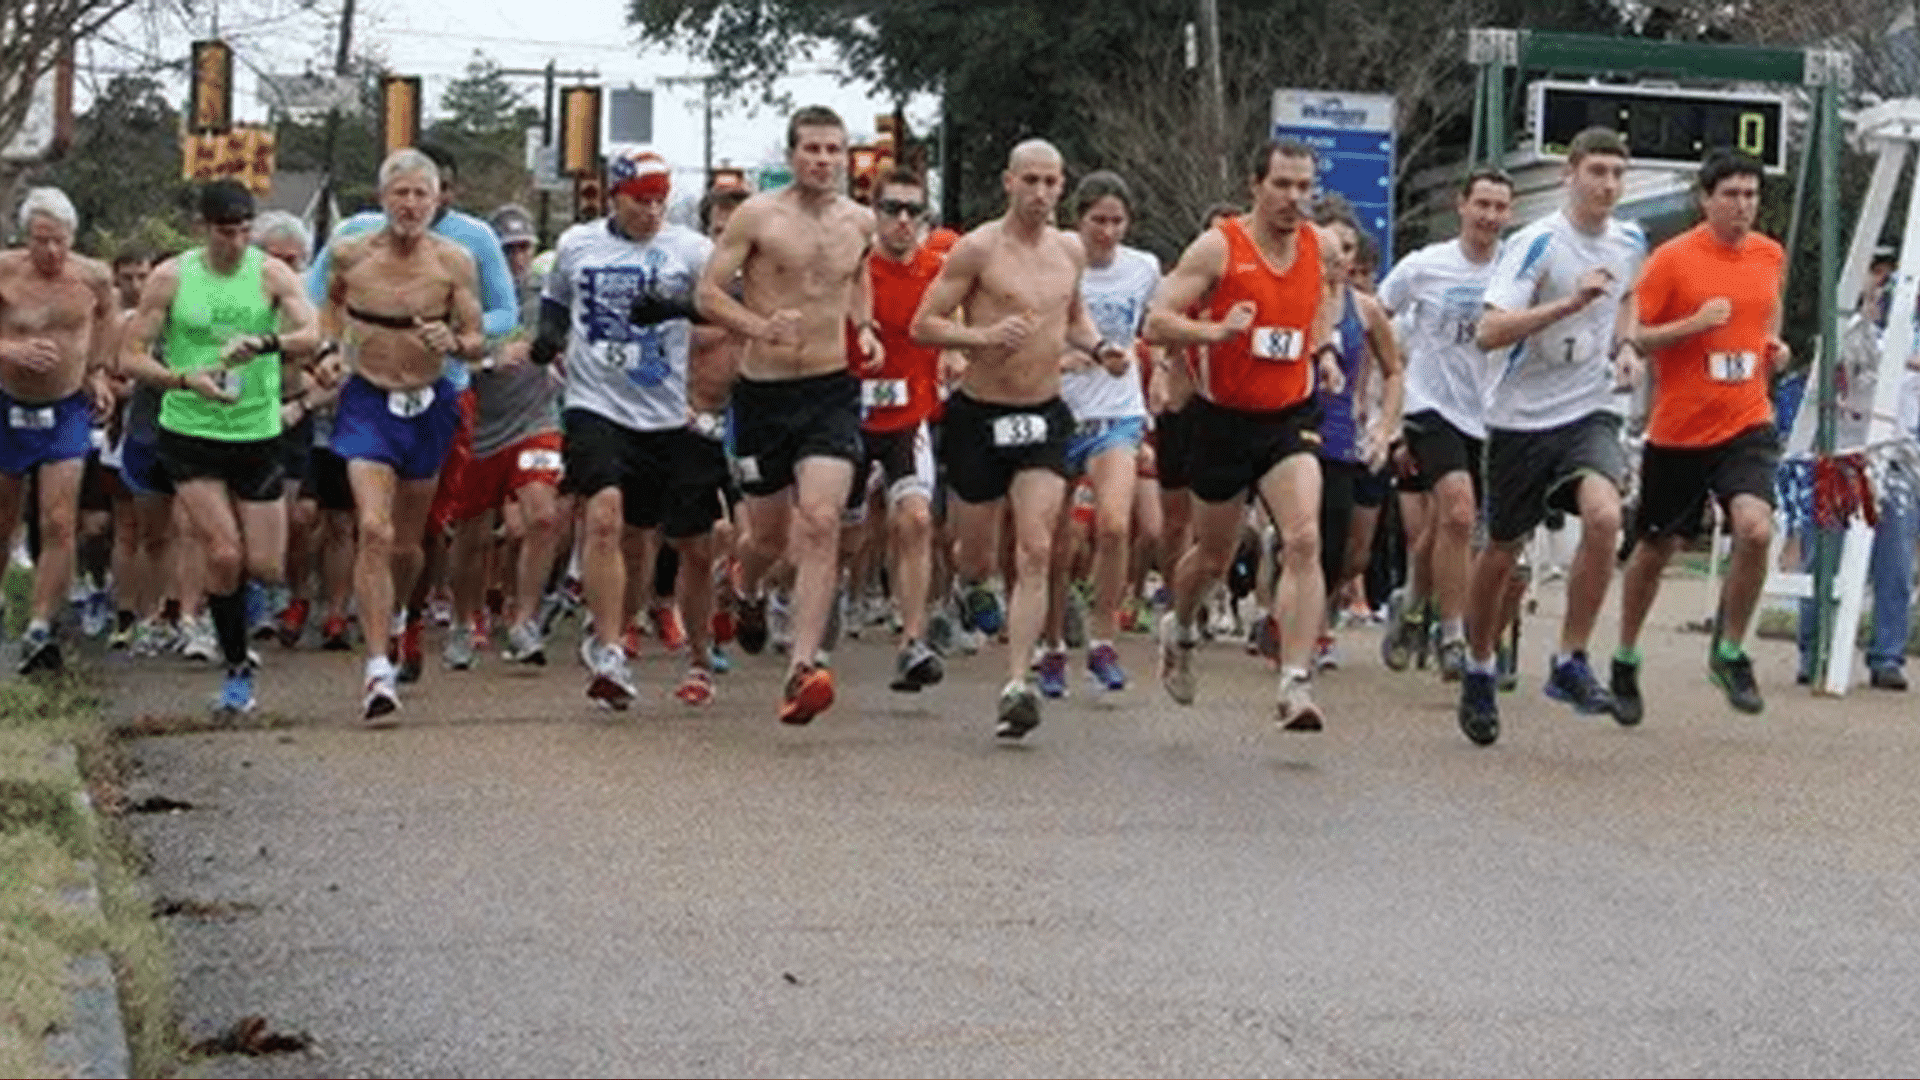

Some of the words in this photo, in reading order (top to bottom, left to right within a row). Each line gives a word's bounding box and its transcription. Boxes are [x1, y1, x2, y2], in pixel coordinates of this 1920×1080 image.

[1738, 112, 1764, 155] 0
[1564, 337, 1576, 363] 7
[1011, 415, 1033, 443] 33
